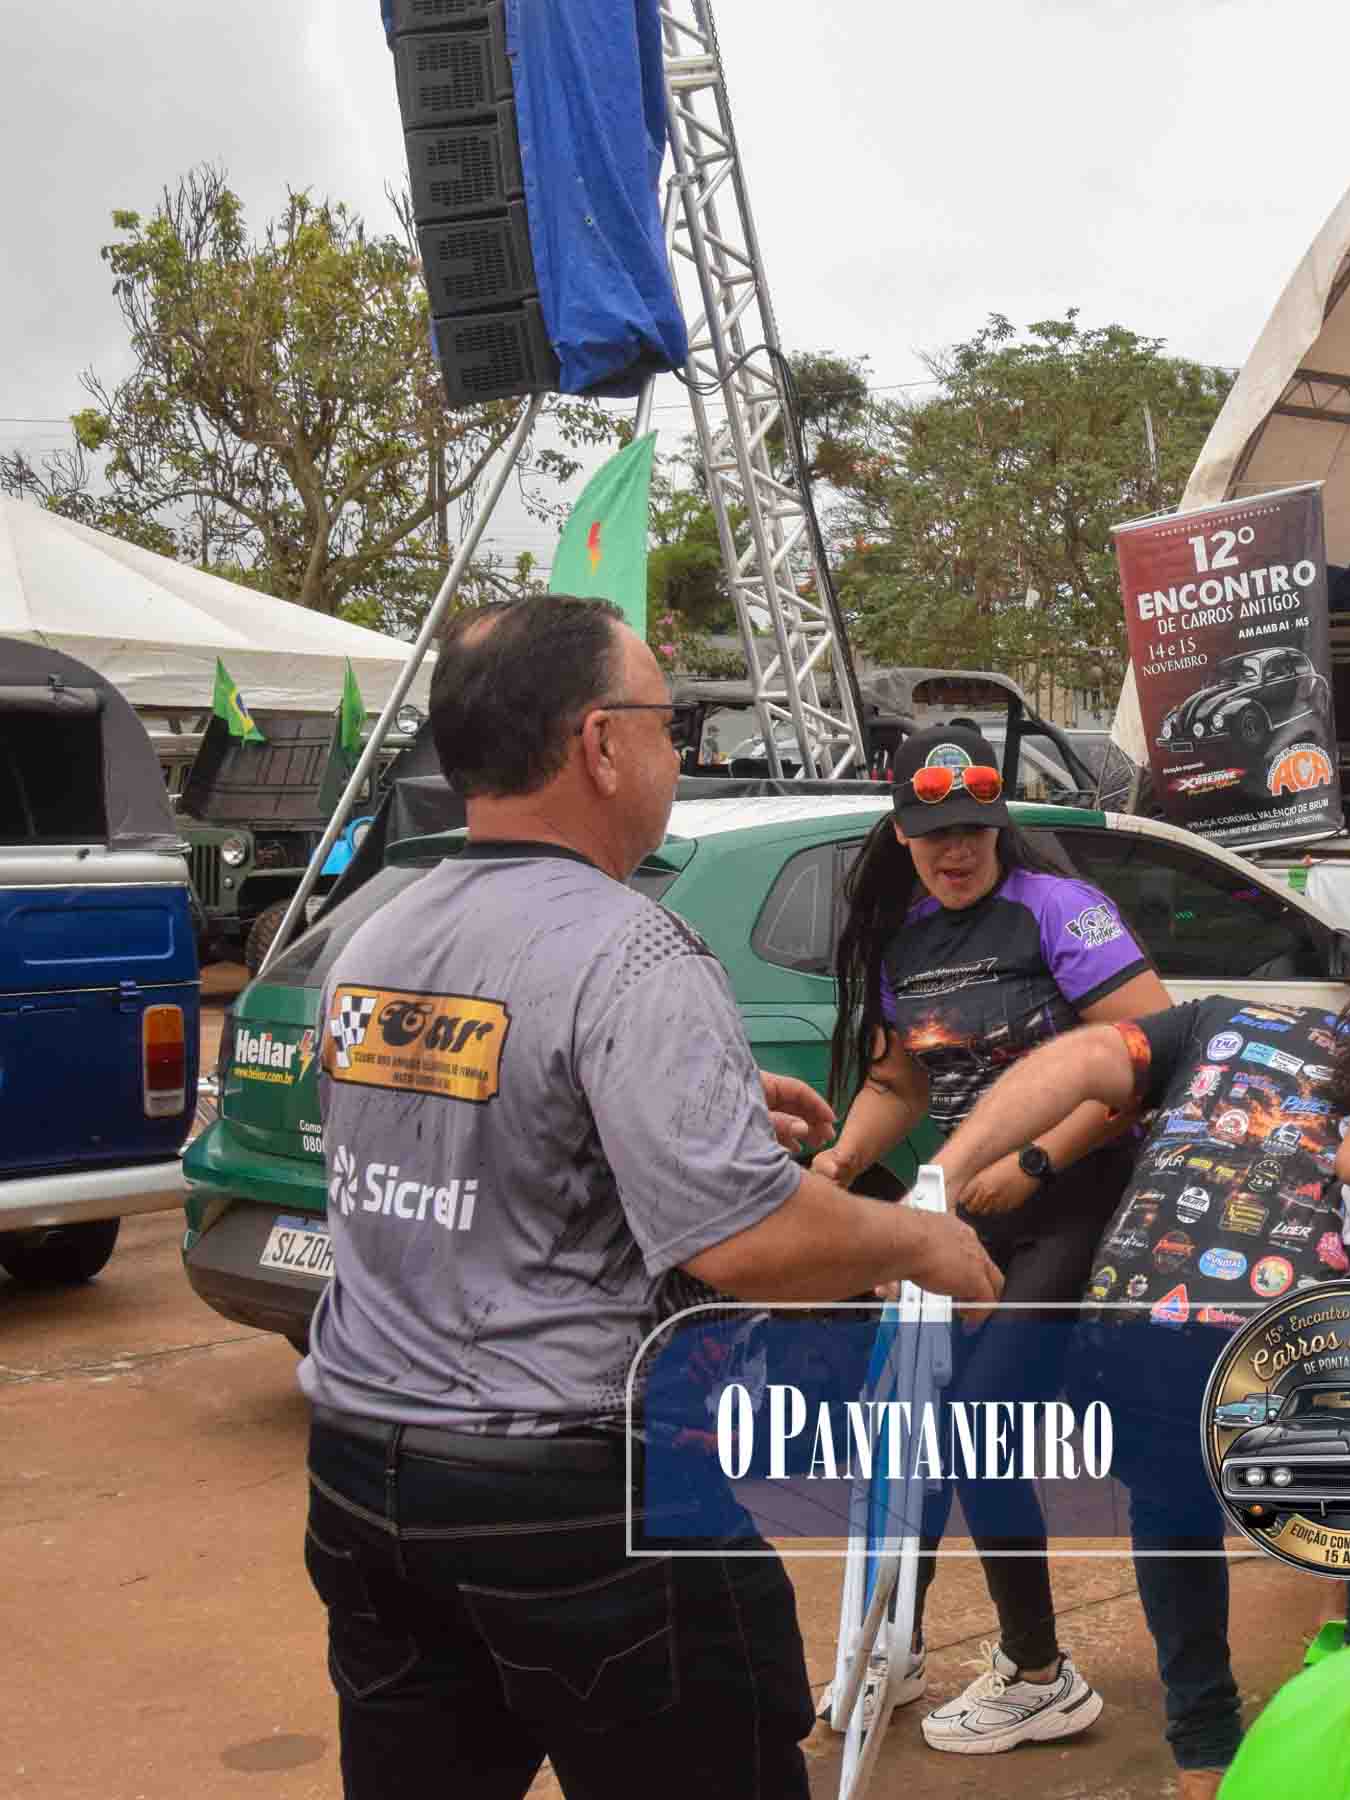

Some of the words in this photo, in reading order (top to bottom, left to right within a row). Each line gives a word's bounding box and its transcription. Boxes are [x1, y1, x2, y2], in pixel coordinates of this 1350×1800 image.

[1137, 560, 1316, 620] ENCONTRO
[1158, 617, 1176, 635] DE
[1181, 605, 1233, 630] CARROS
[1240, 592, 1300, 619] ANTIGOS
[1238, 620, 1290, 640] AMAMBAI
[1295, 616, 1310, 628] MS
[1148, 644, 1165, 660] 14
[1167, 646, 1175, 655] e
[1180, 637, 1197, 653] 15
[1143, 654, 1208, 677] NOVEMBRO
[1298, 803, 1308, 813] DE
[1309, 798, 1329, 811] BRUM
[235, 1028, 297, 1070] Heliar
